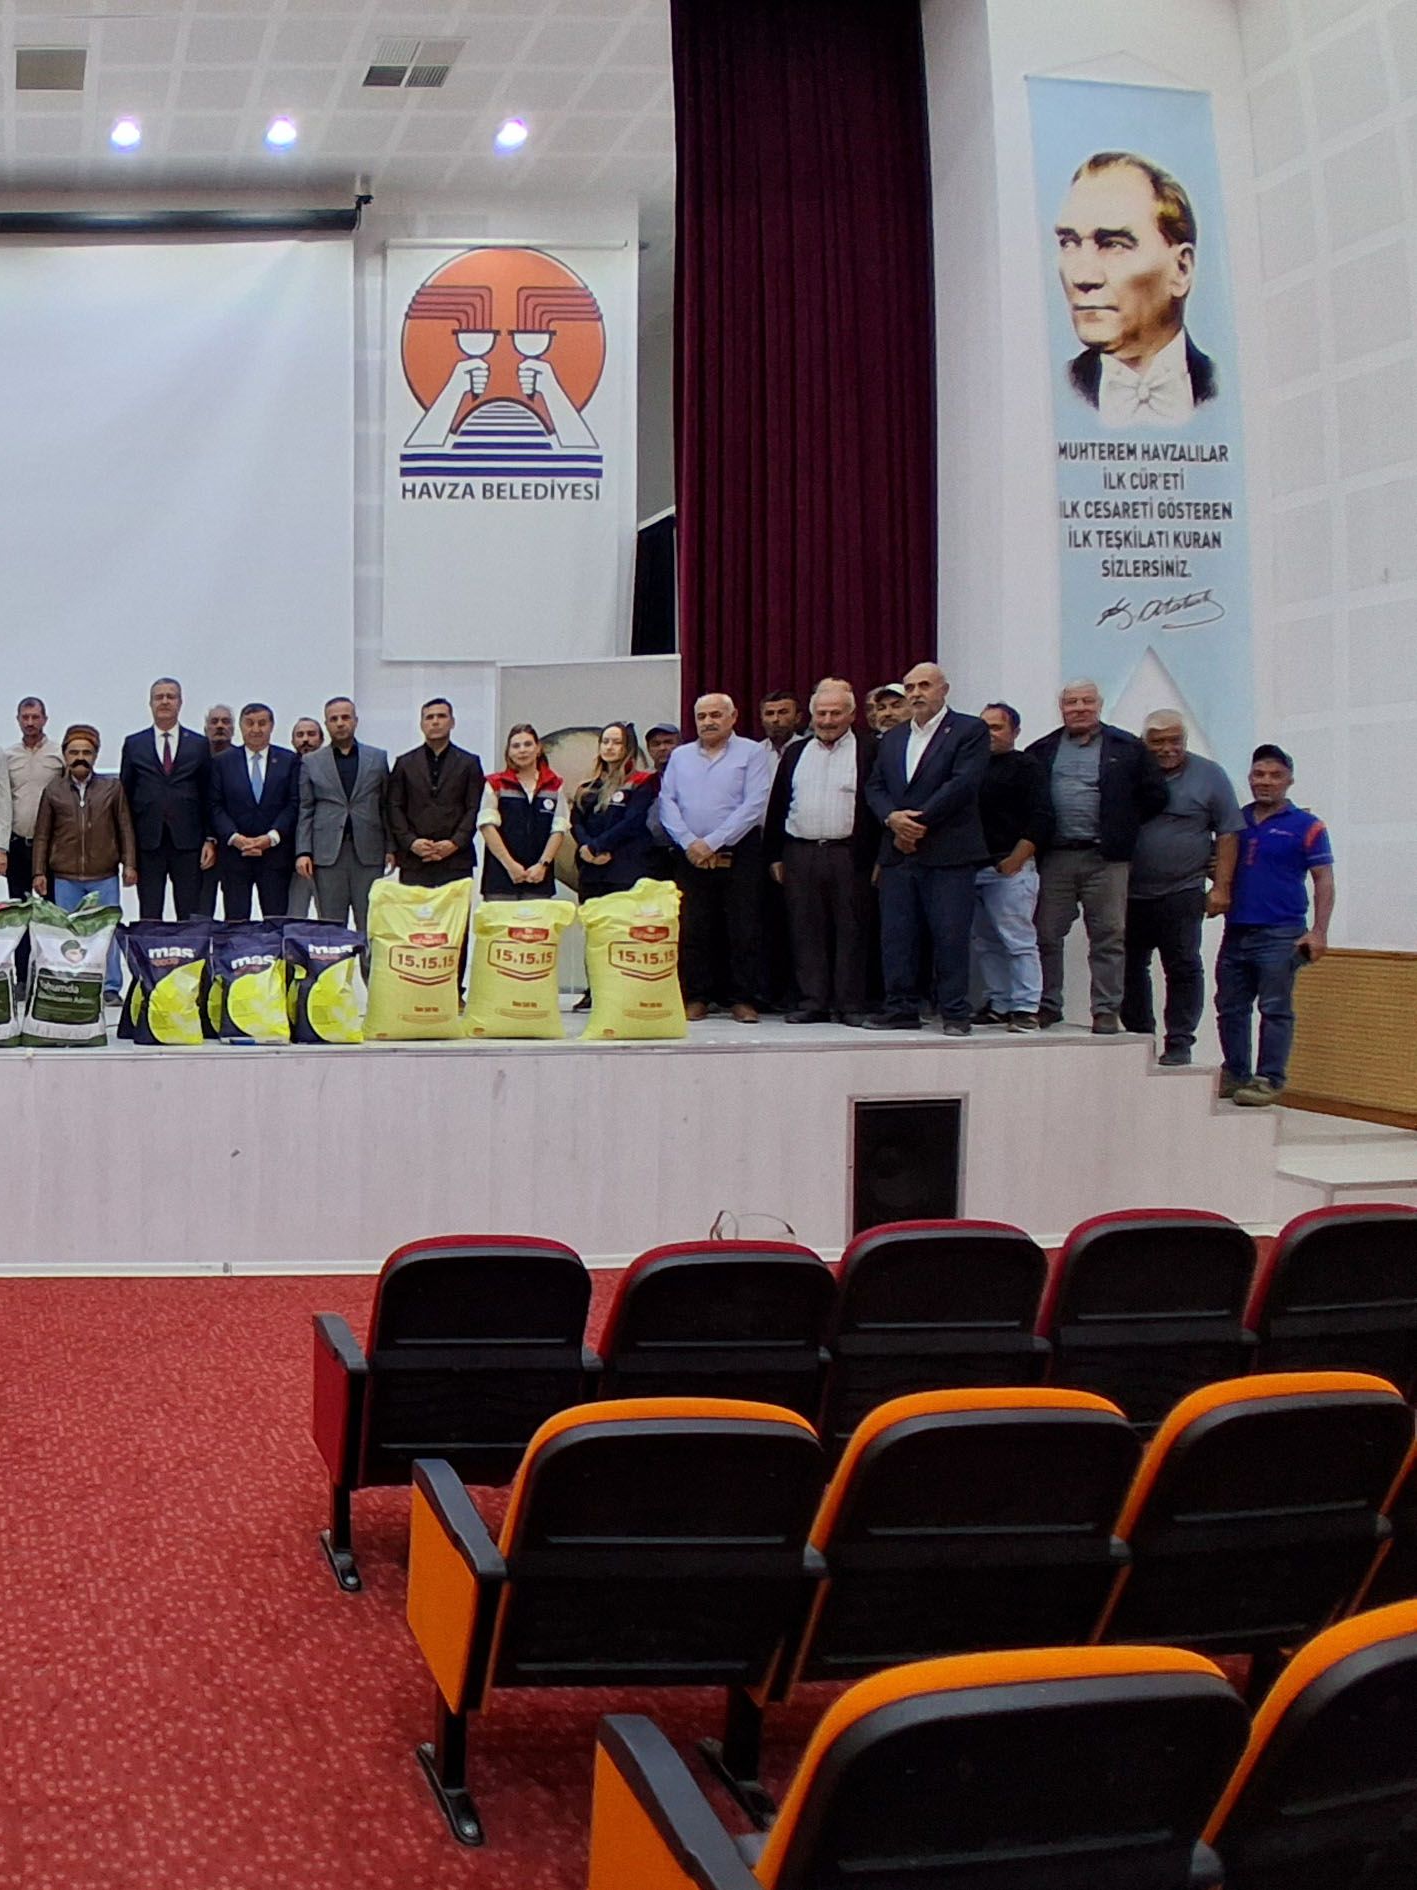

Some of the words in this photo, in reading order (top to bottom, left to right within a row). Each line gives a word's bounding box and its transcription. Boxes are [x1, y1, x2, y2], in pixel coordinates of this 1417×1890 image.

[1058, 442, 1137, 461] MUHTEREM
[1141, 443, 1229, 462] HAVZALILAR
[1103, 467, 1126, 490] İLK
[401, 482, 475, 500] HAVZA
[482, 479, 600, 501] BELEDİYESİ
[1084, 496, 1154, 519] CESARETİ
[1157, 496, 1233, 520] GÖSTEREN
[1068, 525, 1093, 548] İLK
[1095, 525, 1169, 550] TEŞKİLATI
[1173, 530, 1222, 549] KURAN
[148, 946, 195, 960] mas
[308, 943, 354, 955] mas
[495, 949, 553, 965] 15.15.15
[617, 949, 676, 965] 15.15.15
[231, 954, 276, 970] mas
[397, 953, 455, 969] 15.15.15
